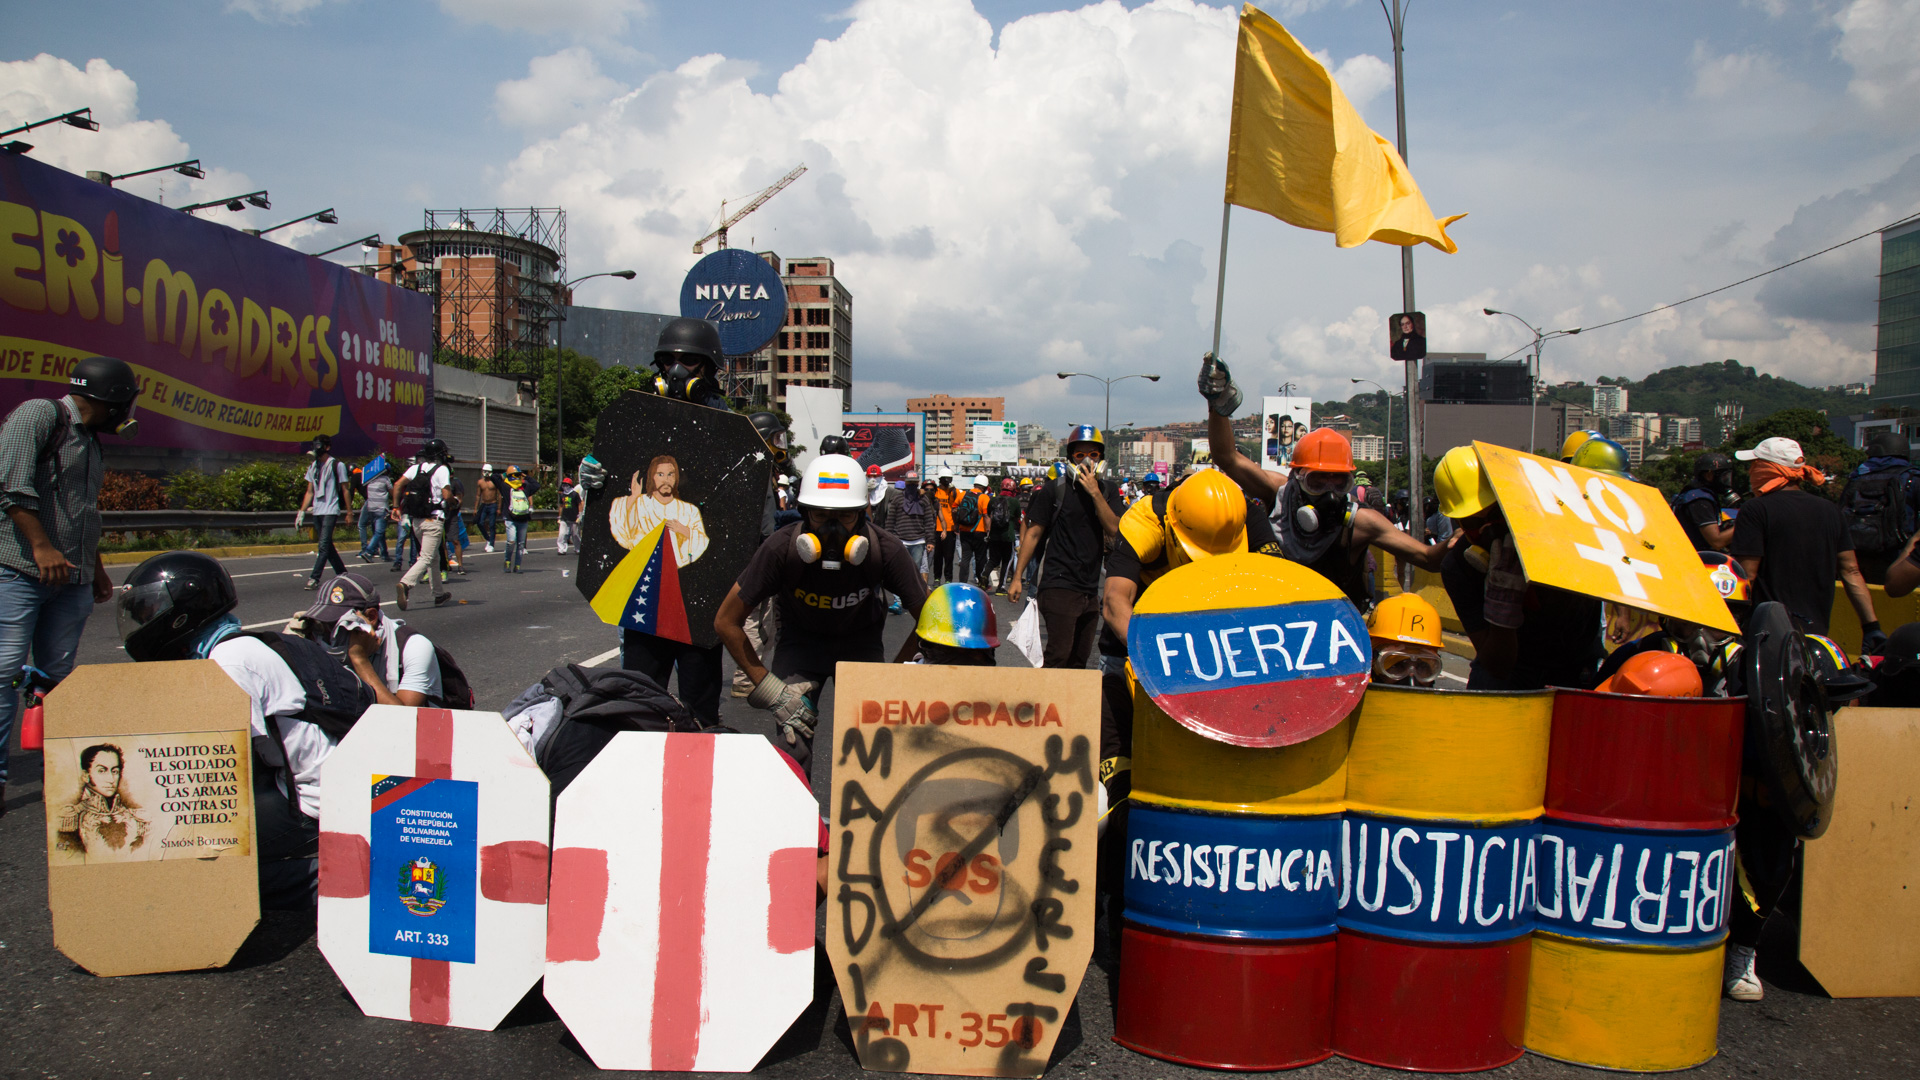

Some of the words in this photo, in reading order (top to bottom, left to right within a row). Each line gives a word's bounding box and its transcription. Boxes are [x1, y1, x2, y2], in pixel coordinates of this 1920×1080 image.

[696, 283, 770, 300] NIVEA
[705, 301, 760, 321] Creme
[379, 318, 399, 346] DEL
[341, 331, 360, 362] 21
[365, 340, 380, 366] DE
[384, 344, 416, 373] ABRIL
[418, 352, 430, 376] AL
[356, 370, 374, 400] 13
[378, 377, 392, 403] DE
[394, 381, 424, 407] MAYO
[152, 381, 168, 403] EL
[171, 390, 216, 419] MEJOR
[218, 404, 263, 428] REGALO
[264, 413, 293, 432] PARA
[295, 415, 324, 432] ELLAS
[1518, 456, 1646, 535] NO
[1411, 614, 1424, 633] R
[1155, 619, 1365, 681] FUERZA
[861, 699, 1064, 728] DEMOCRACIA
[212, 744, 237, 756] SEA
[150, 761, 168, 772] EL
[169, 758, 237, 771] SOLDADO
[155, 774, 186, 788] QUE
[187, 771, 238, 785] VUELVA
[165, 787, 192, 799] LAS
[193, 785, 238, 798] ARMAS
[160, 801, 218, 813] CONTRA
[220, 799, 238, 810] SU
[400, 808, 453, 819] CONSTITUCIÓN
[396, 817, 406, 825] DE
[407, 818, 417, 826] LA
[417, 818, 458, 829] REPÚBLICA
[403, 826, 450, 837] BOLIVARIANA
[400, 835, 410, 843] DE
[410, 836, 453, 846] VENEZUELA
[902, 848, 1002, 894] SOS
[1130, 838, 1335, 893] RESISTENCIA
[1338, 820, 1536, 927] JUSTICIA
[394, 930, 424, 944] ART.
[427, 933, 449, 946] 333
[858, 1001, 952, 1039] ART.
[958, 1012, 1044, 1051] 350
